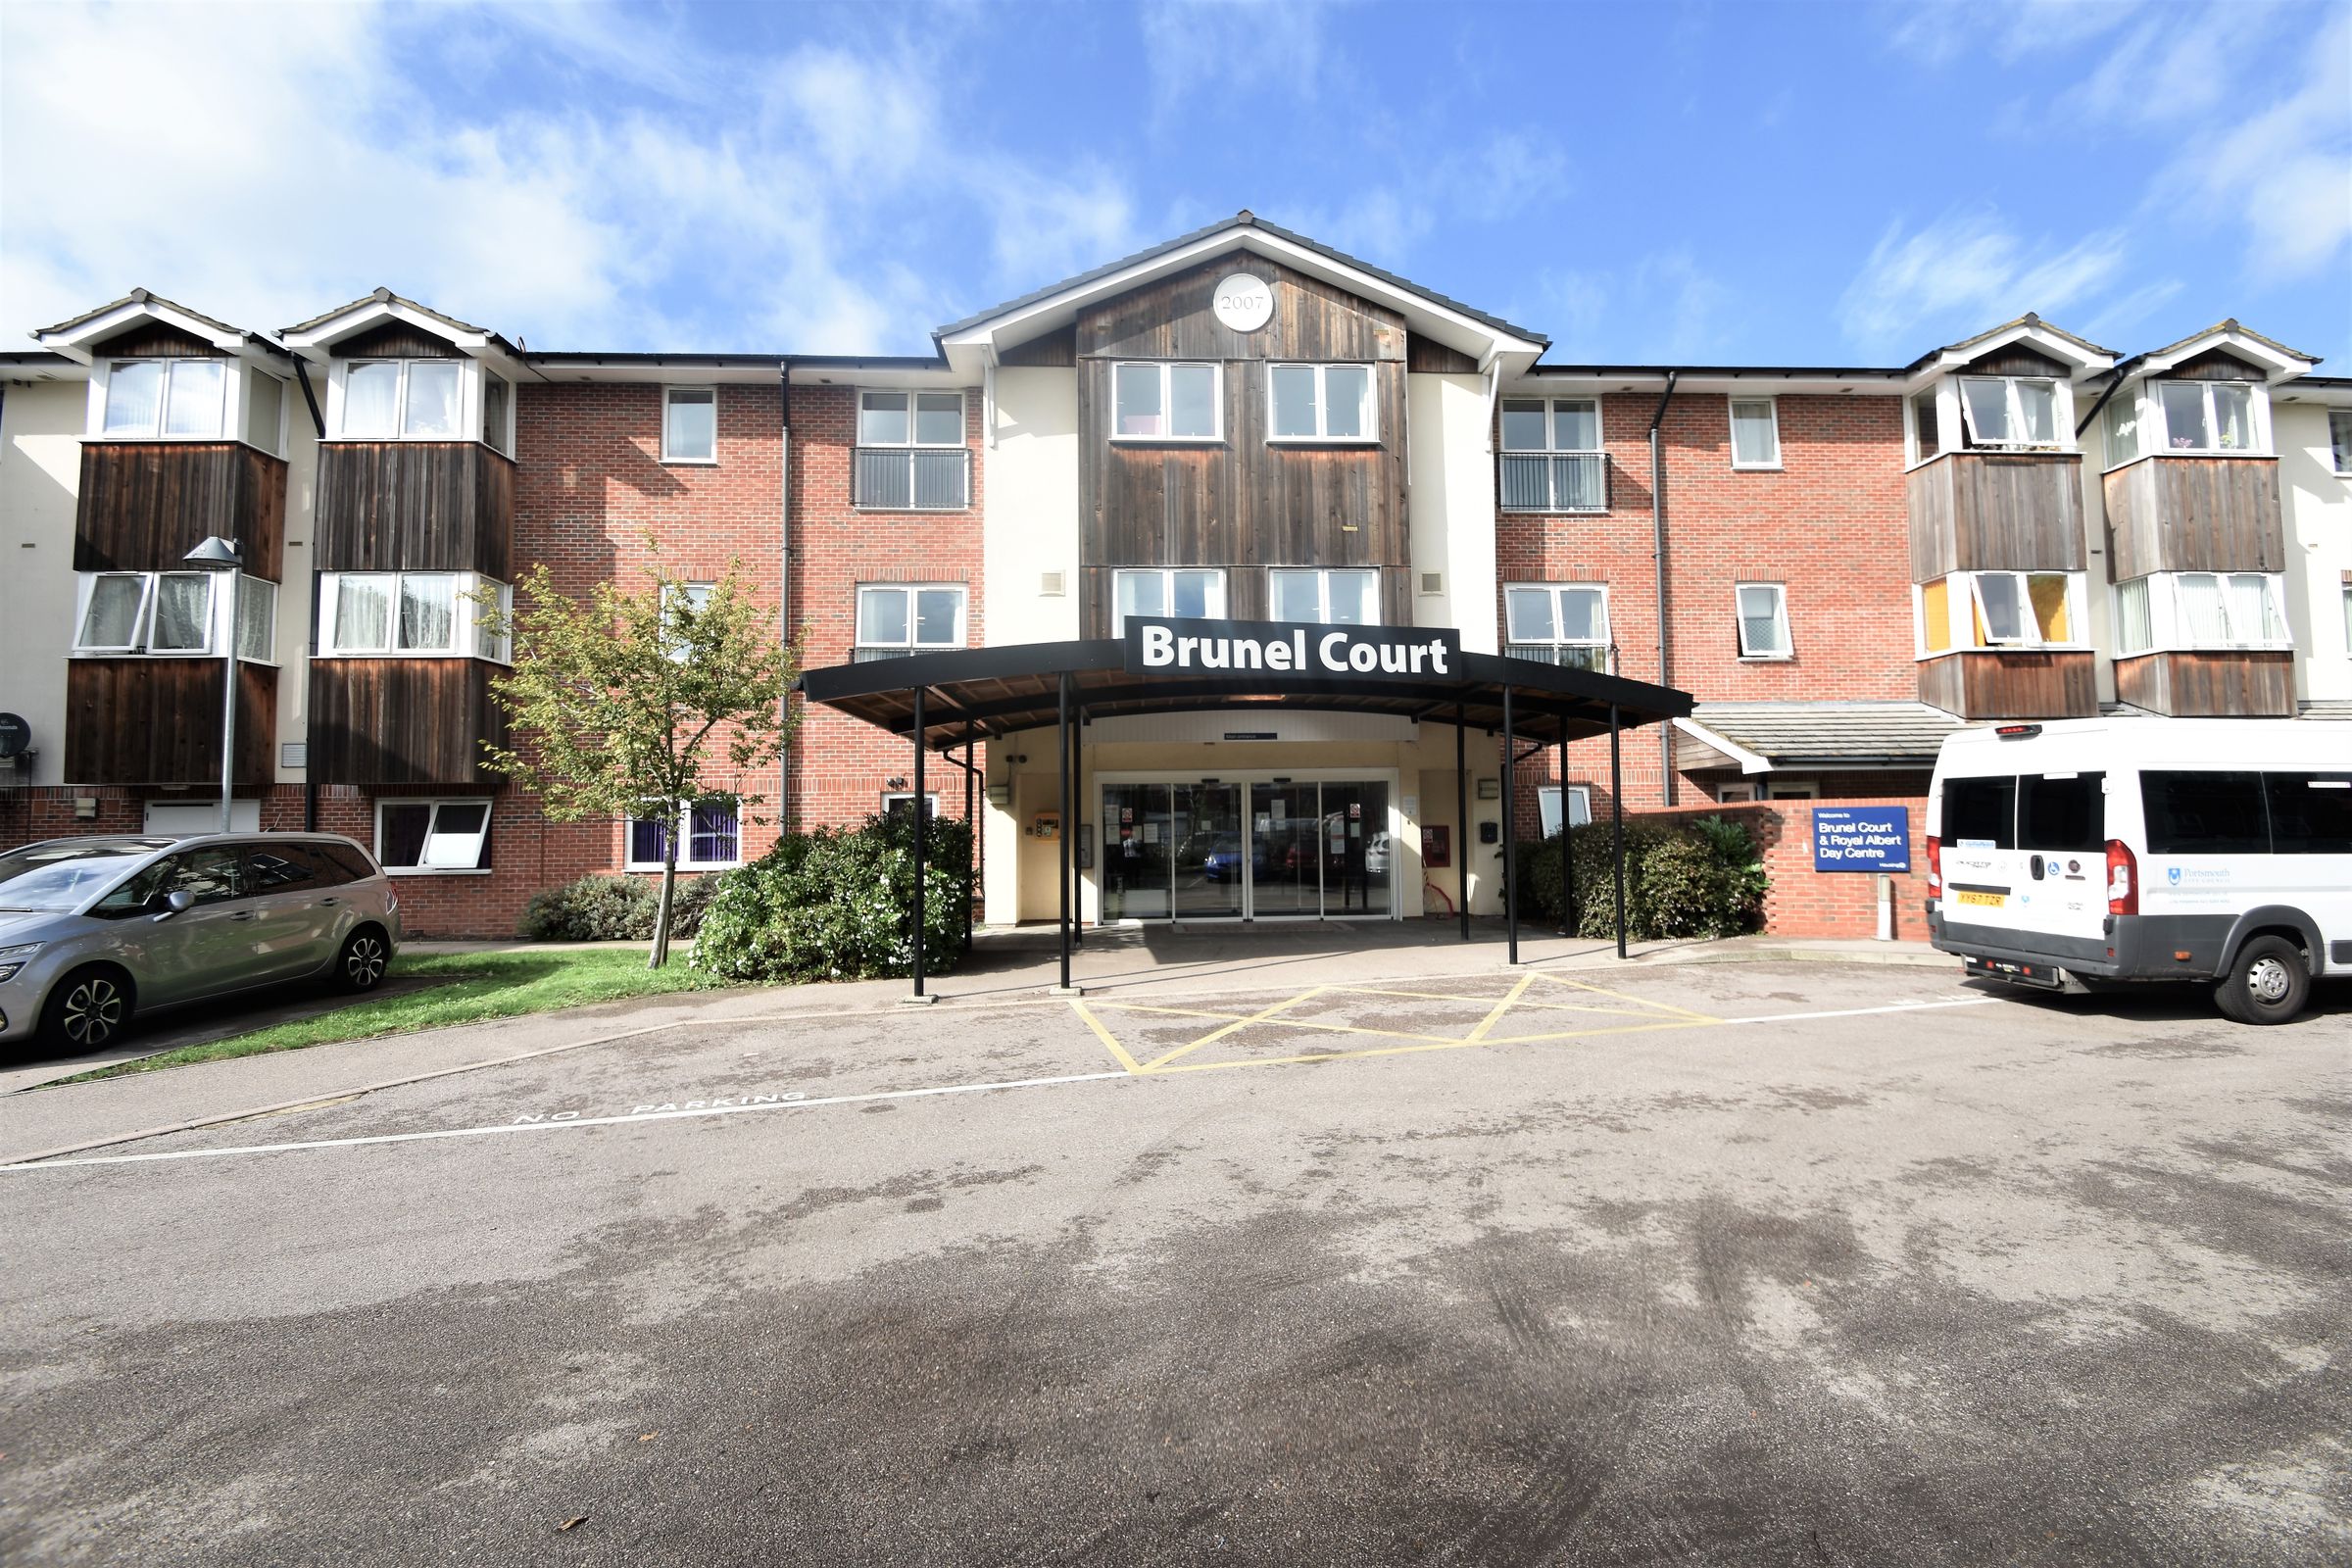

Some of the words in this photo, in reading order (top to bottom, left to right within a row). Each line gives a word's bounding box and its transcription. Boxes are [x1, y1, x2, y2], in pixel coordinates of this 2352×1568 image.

[1221, 296, 1264, 310] 2007
[1142, 625, 1306, 670] Brunel
[1318, 631, 1448, 674] Court
[1818, 822, 1856, 833] Brunel
[1857, 821, 1892, 833] Court
[1819, 835, 1829, 846] &
[1831, 835, 1863, 848] Royal
[1865, 834, 1902, 846] Albert
[1819, 848, 1842, 859] Day
[1844, 847, 1886, 858] Centre
[2183, 867, 2230, 877] Portsmouth
[513, 1110, 580, 1124] NO
[630, 1091, 807, 1115] PARKING
